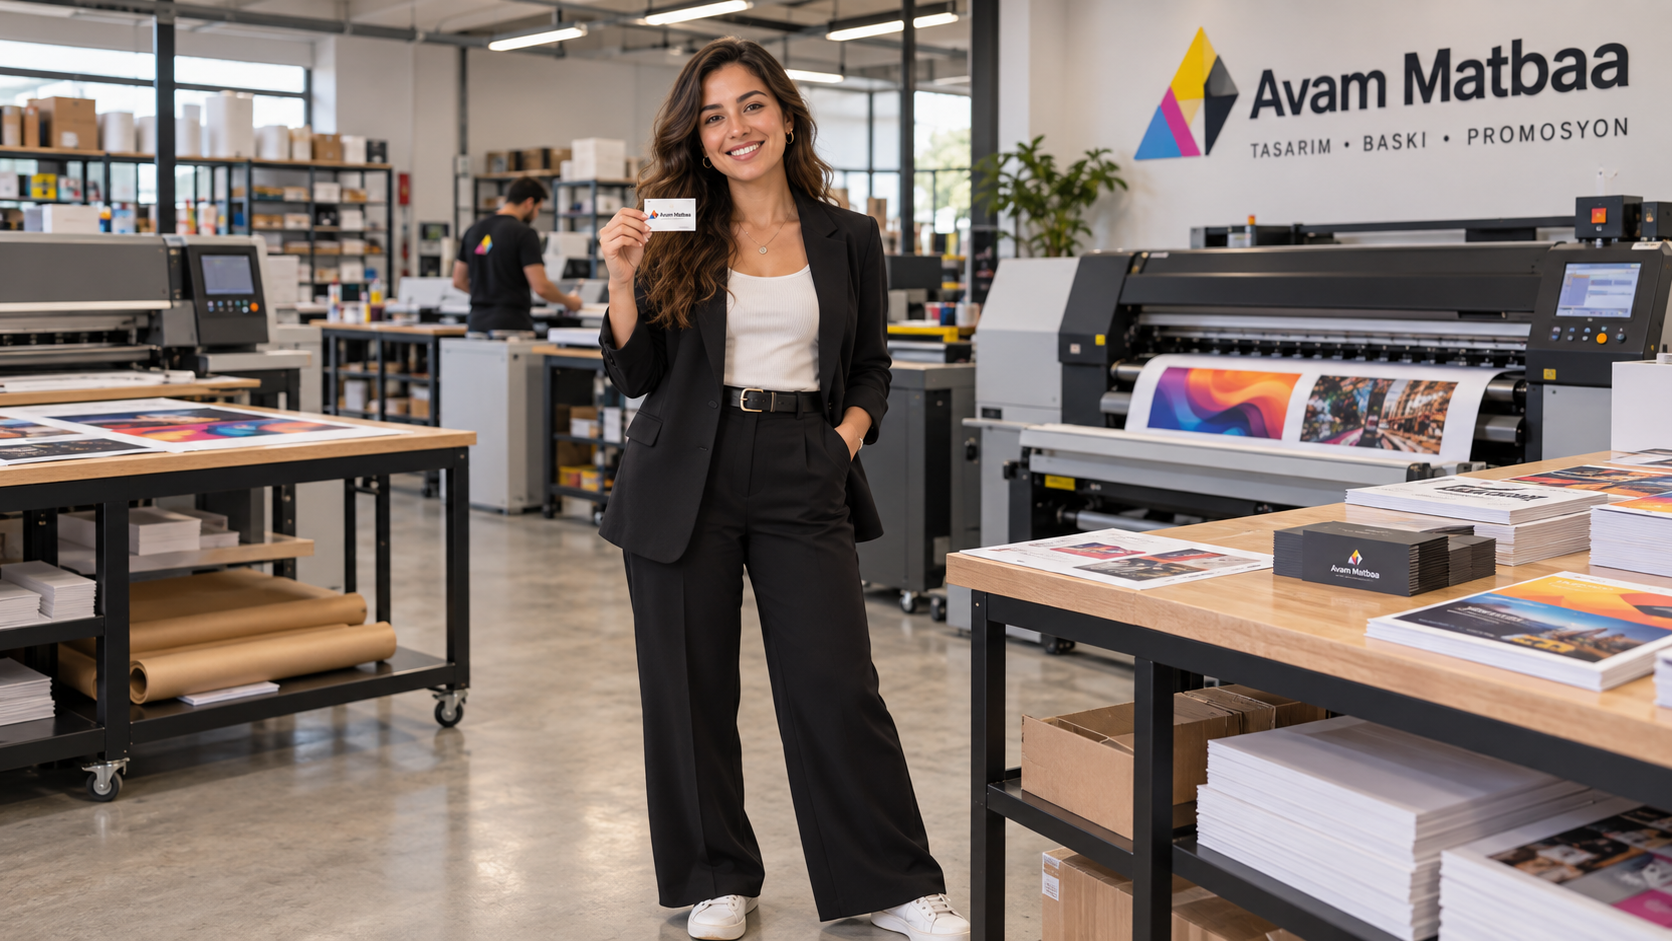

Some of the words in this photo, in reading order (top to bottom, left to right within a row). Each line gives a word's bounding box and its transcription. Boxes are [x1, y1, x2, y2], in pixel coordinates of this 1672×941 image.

[1250, 69, 1386, 119] Avam
[1404, 39, 1629, 105] Matbaa
[1251, 138, 1331, 158] TASARIM
[1363, 131, 1427, 152] BASKI
[1467, 117, 1629, 146] PROMOSYON
[1331, 564, 1351, 575] Avam
